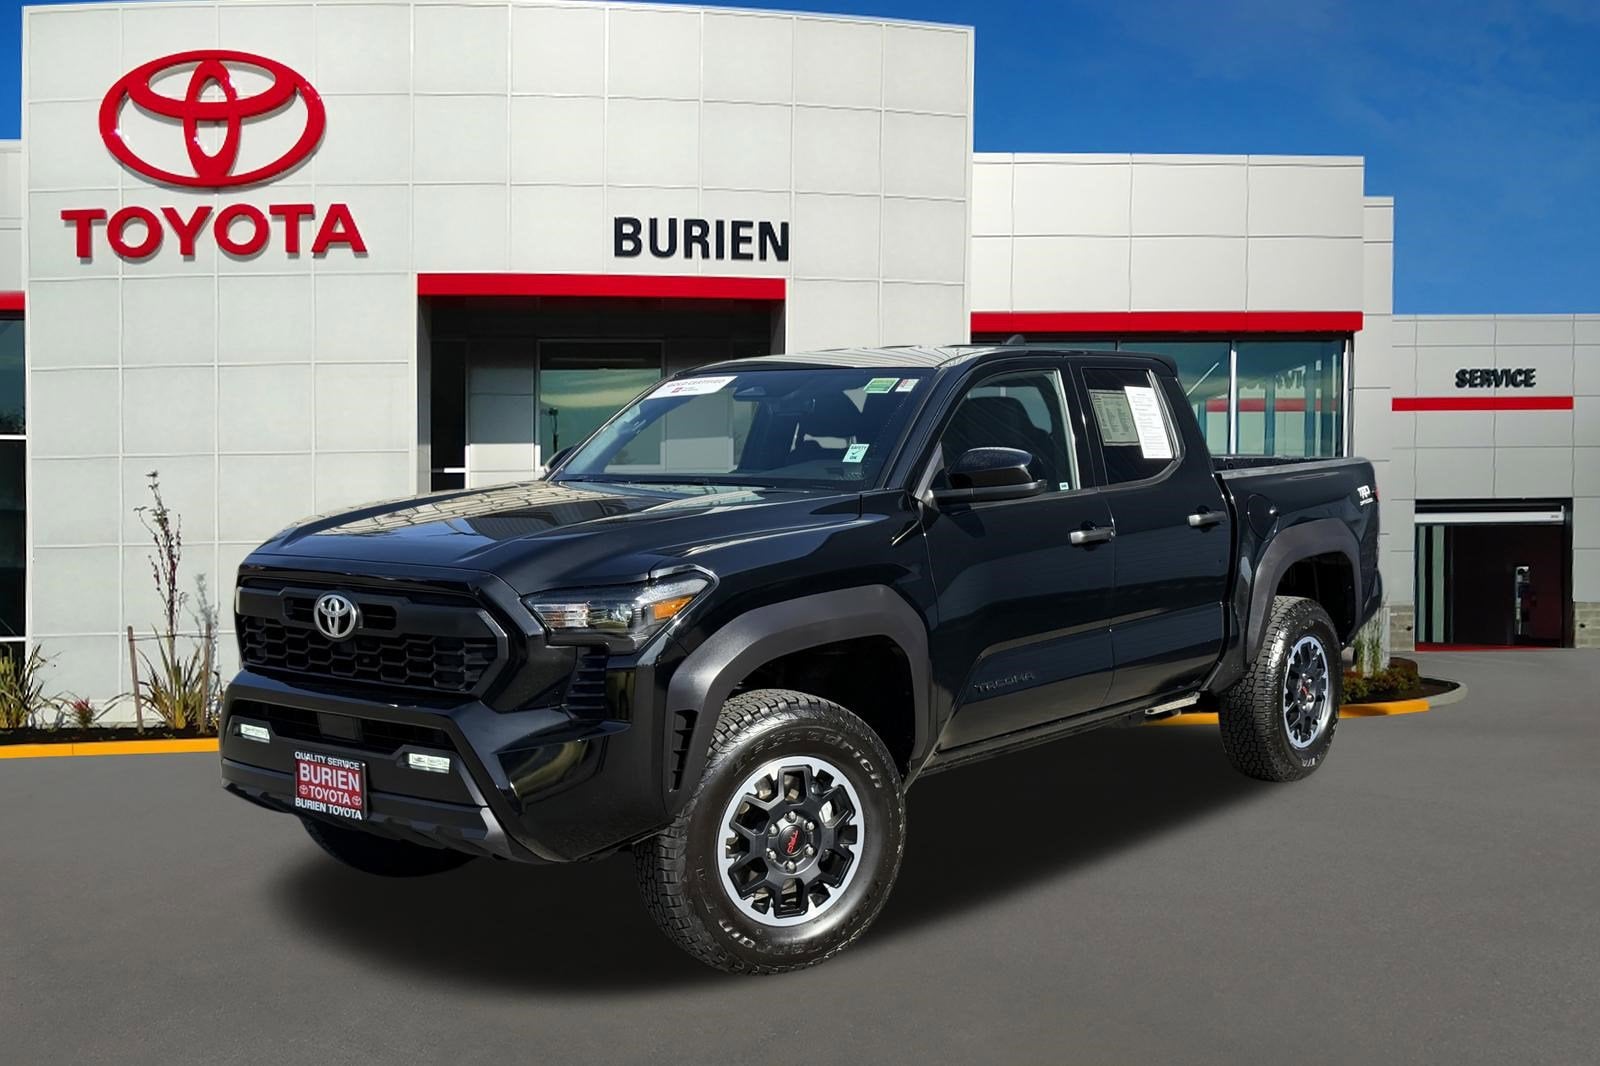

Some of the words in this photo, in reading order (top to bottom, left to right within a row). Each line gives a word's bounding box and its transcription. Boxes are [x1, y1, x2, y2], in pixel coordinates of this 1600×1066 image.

[61, 204, 368, 258] TOYOTA
[614, 217, 790, 262] BURIEN
[1455, 368, 1536, 388] SERVICE
[295, 751, 326, 764] QUALITY
[327, 757, 360, 770] SERVICE
[299, 762, 360, 792] BURIEN
[308, 785, 351, 806] TOYOTA
[295, 797, 326, 812] BURIEN
[327, 803, 362, 820] TOYOTA
[786, 829, 799, 854] TRD
